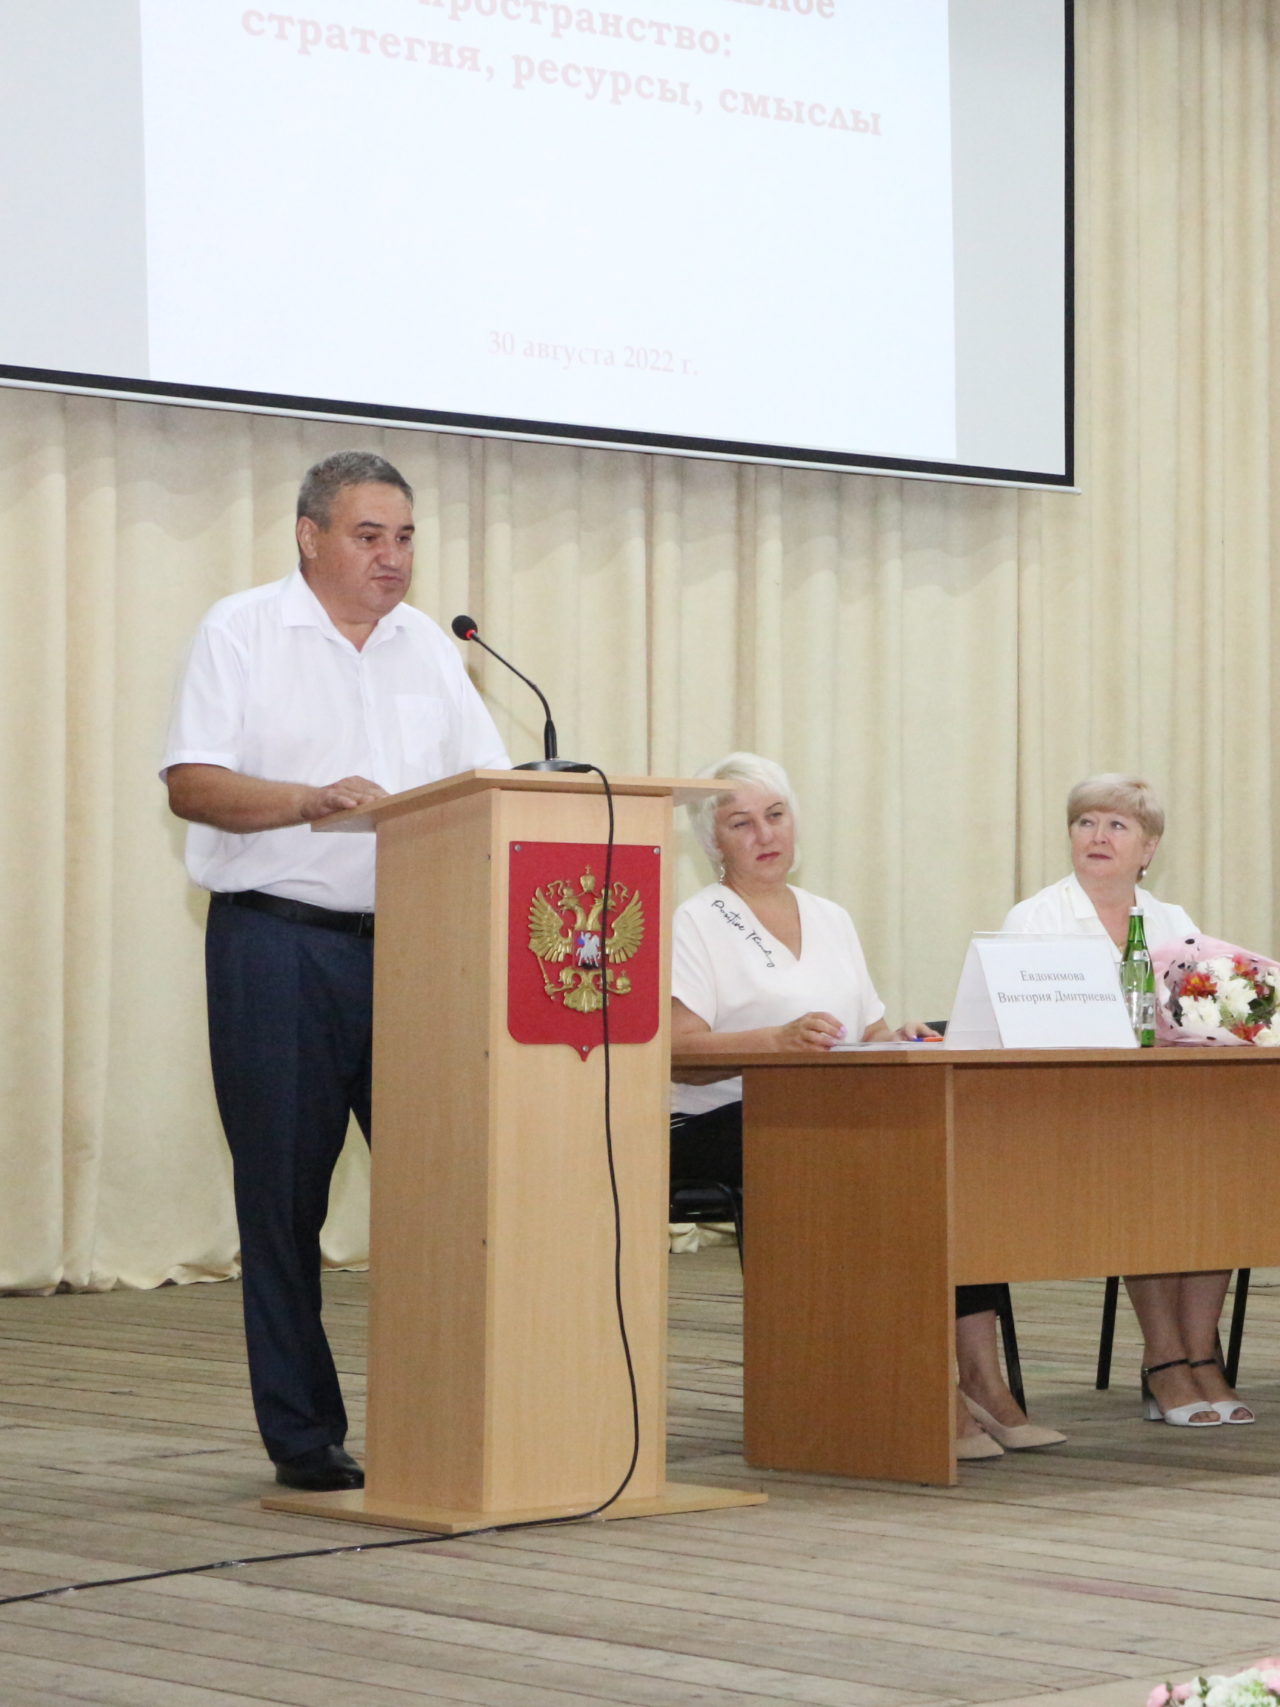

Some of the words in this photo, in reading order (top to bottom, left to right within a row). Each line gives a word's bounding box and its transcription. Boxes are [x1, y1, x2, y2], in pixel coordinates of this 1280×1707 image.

[418, 0, 733, 58] ространство:
[241, 8, 495, 82] стратегия,
[511, 53, 705, 115] ресурсы,
[718, 87, 883, 136] смыслы
[487, 329, 516, 356] 30
[522, 338, 616, 371] августа
[622, 345, 675, 374] 2022
[680, 359, 700, 376] г.
[997, 990, 1052, 1004] Виктория
[1053, 989, 1117, 1004] Дмитриевна
[1019, 969, 1086, 982] Евдокимова
